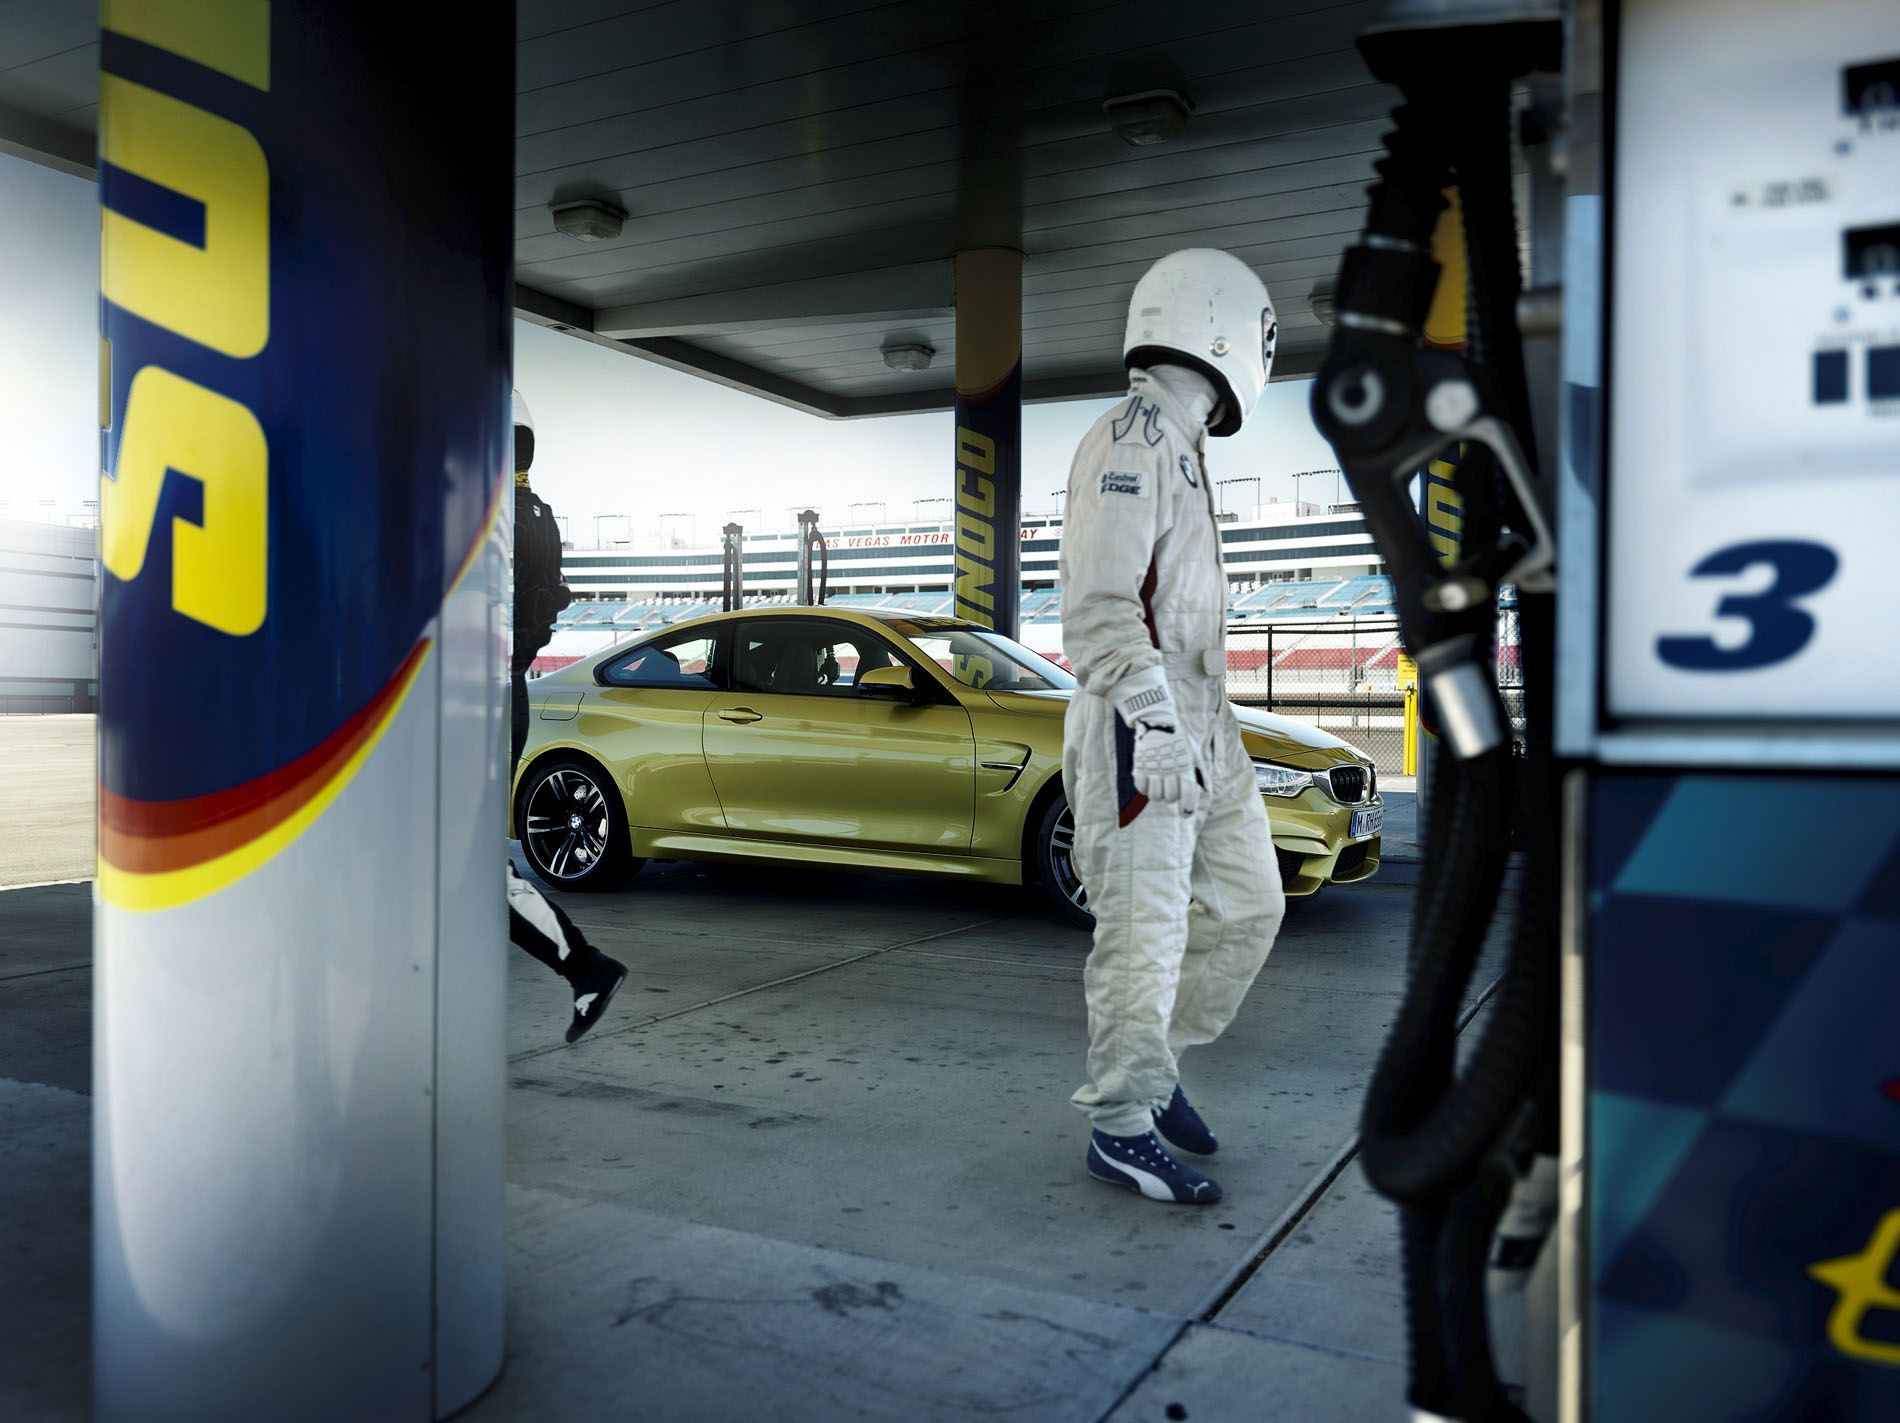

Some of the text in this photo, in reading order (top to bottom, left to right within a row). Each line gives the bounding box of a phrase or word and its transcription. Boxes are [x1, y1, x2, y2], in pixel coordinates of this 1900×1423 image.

[848, 537, 891, 548] VEGAS
[900, 533, 949, 545] MOTOR
[1656, 537, 1840, 673] 3
